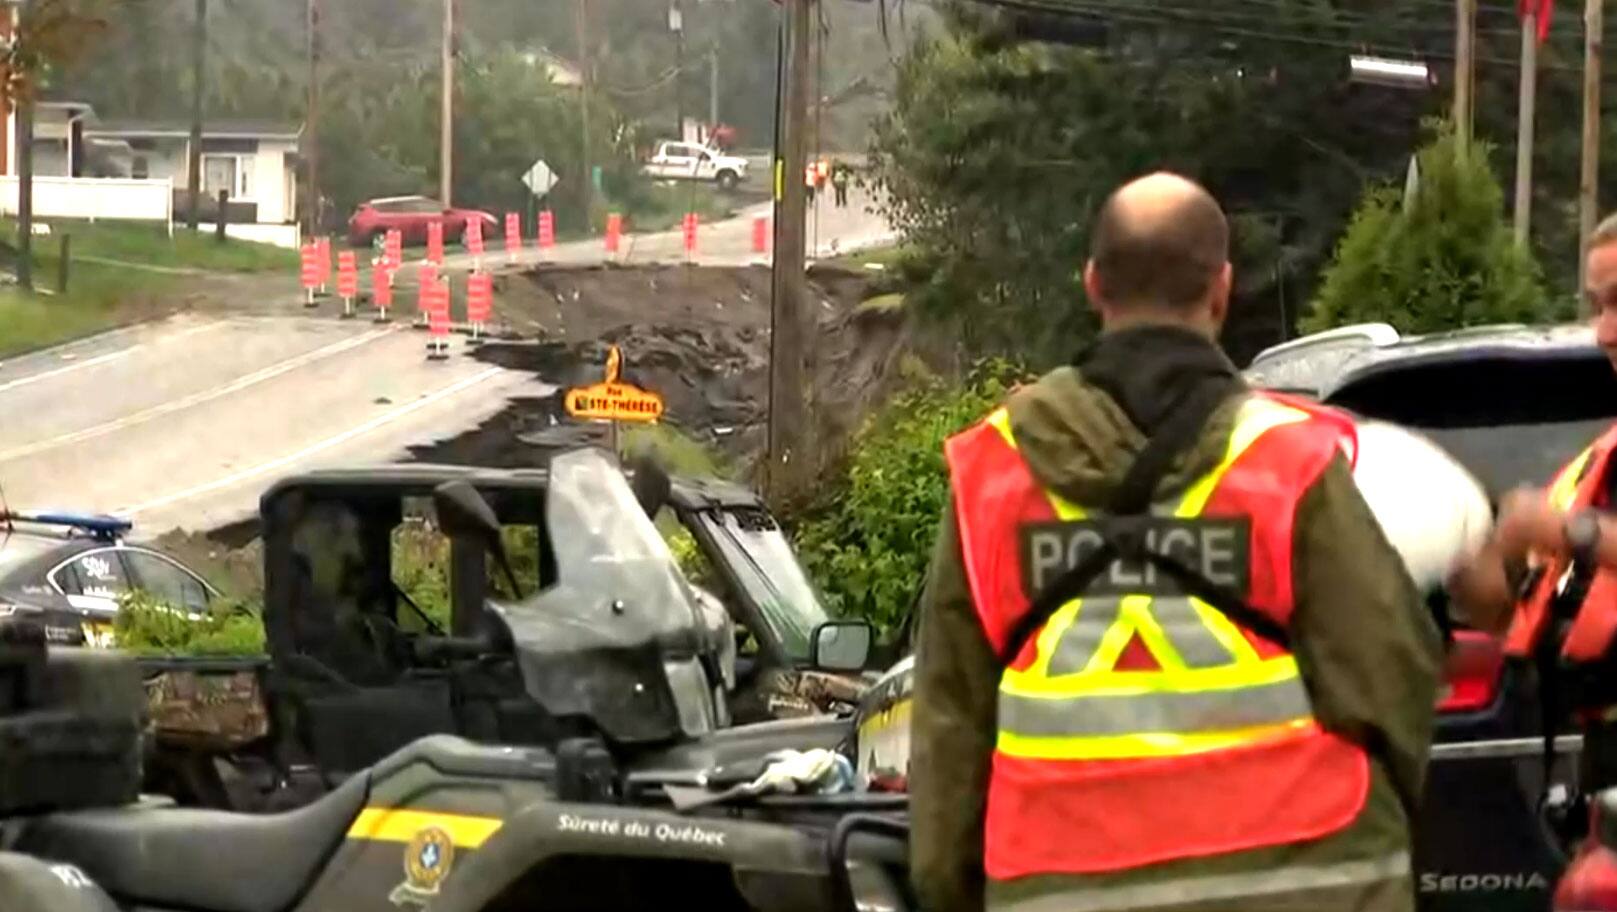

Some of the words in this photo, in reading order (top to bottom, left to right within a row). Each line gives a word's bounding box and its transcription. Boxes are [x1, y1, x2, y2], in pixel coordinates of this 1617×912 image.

[557, 813, 620, 836] Sûreté
[623, 820, 650, 838] du
[655, 819, 727, 846] Québec
[1420, 872, 1549, 893] SEDONA
